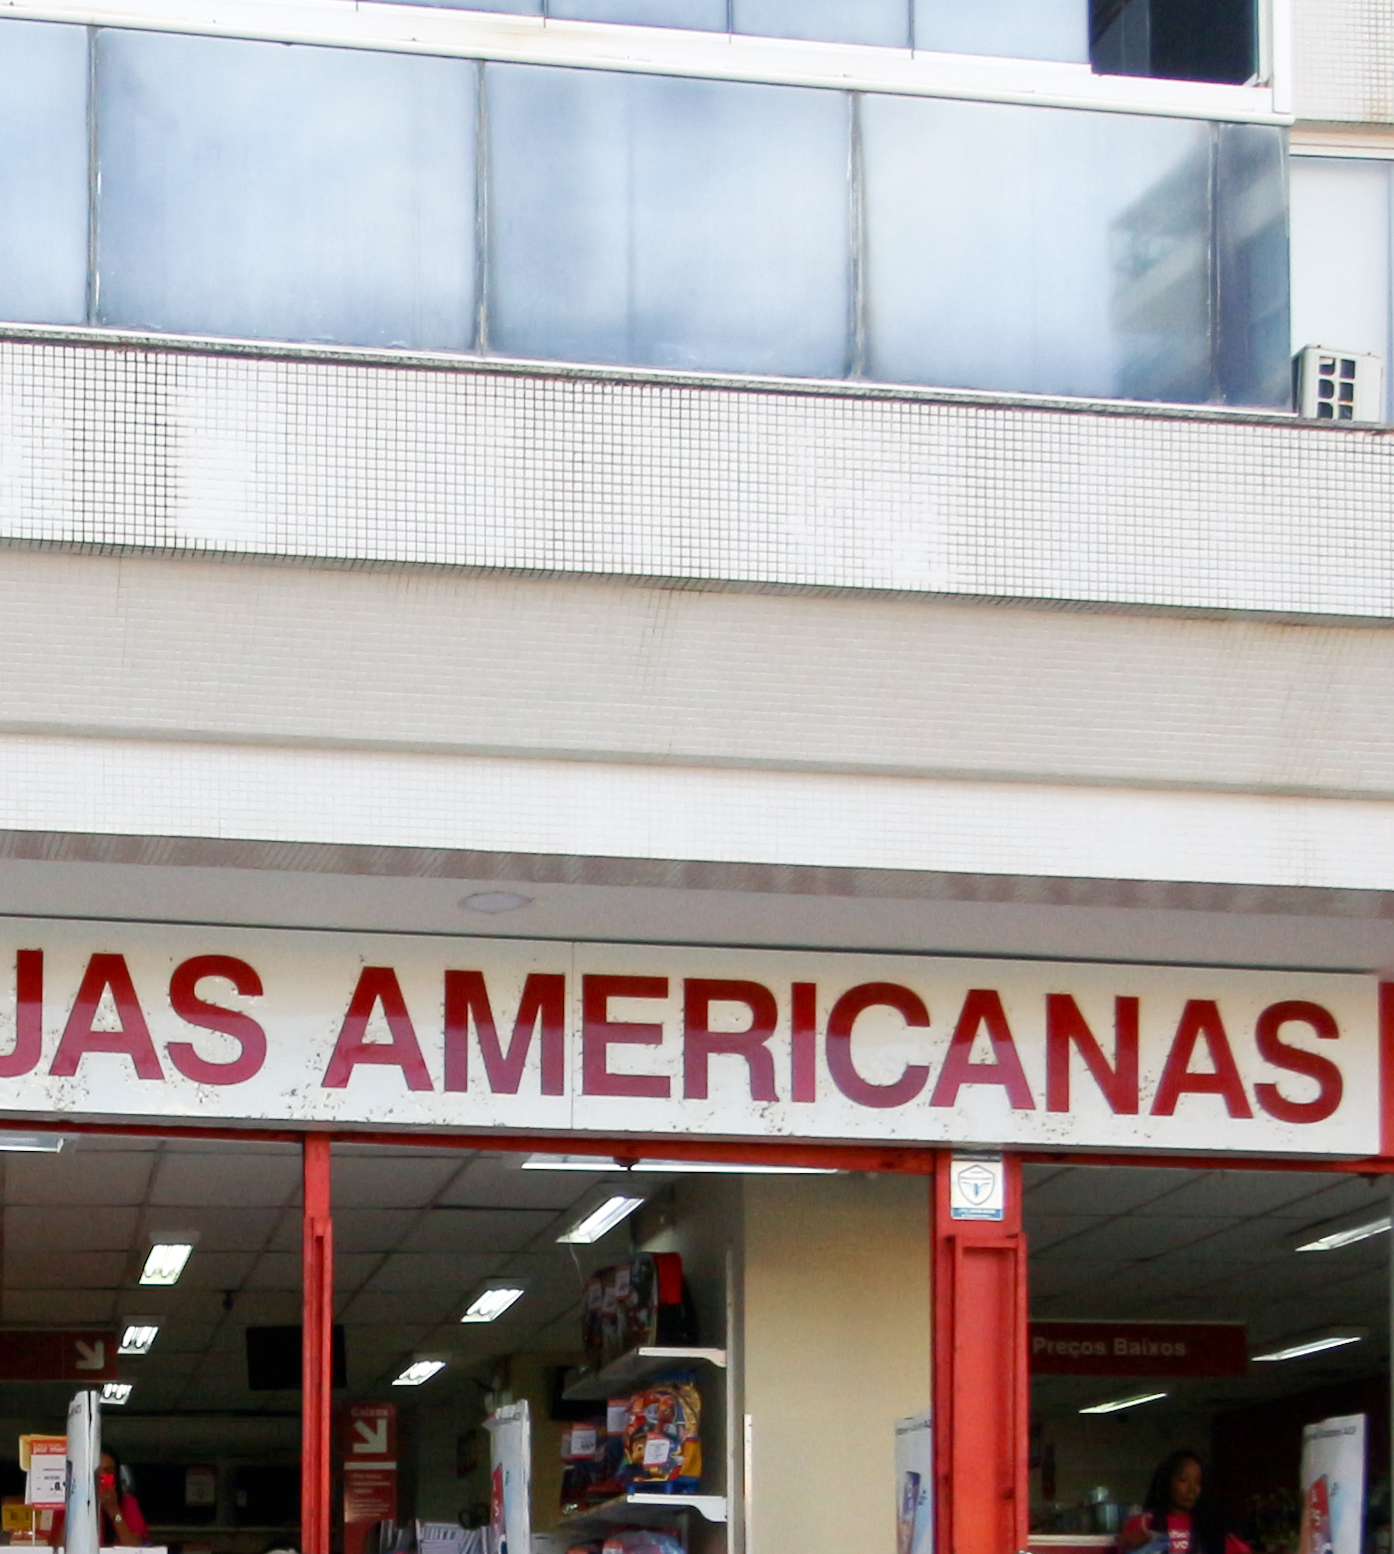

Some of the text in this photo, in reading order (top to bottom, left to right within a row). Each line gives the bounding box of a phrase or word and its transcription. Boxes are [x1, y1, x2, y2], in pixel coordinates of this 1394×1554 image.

[322, 966, 1344, 1125] AMERICANAS
[1032, 1337, 1187, 1358] Preços Baixos
